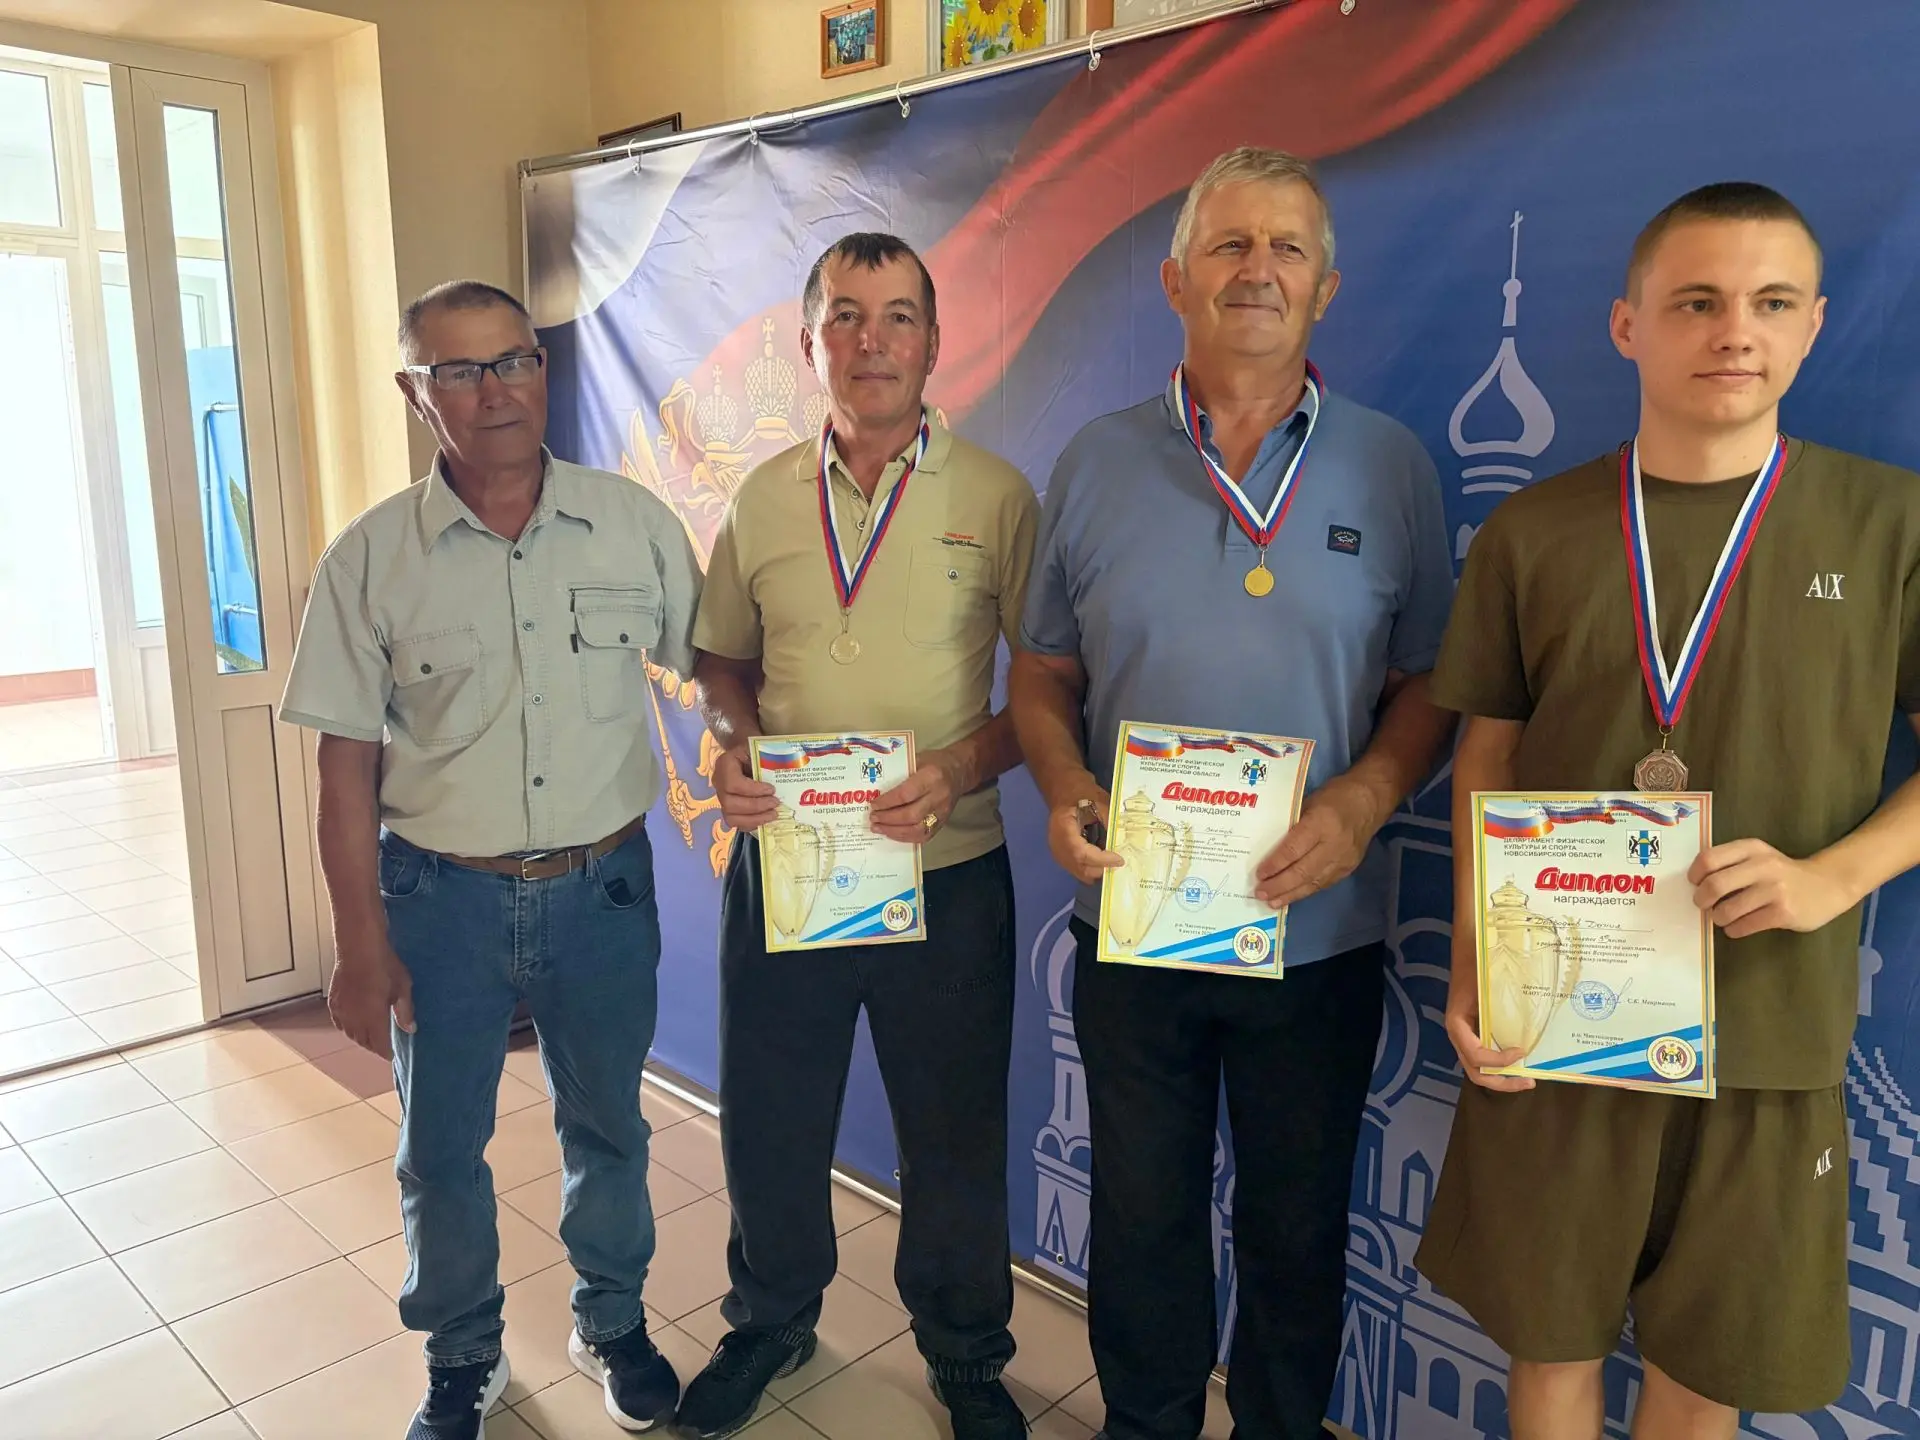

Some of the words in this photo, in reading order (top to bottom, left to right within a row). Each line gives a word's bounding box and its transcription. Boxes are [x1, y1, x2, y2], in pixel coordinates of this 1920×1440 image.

[813, 806, 869, 815] награждается
[1175, 805, 1241, 816] награждается
[1553, 895, 1636, 907] награждается
